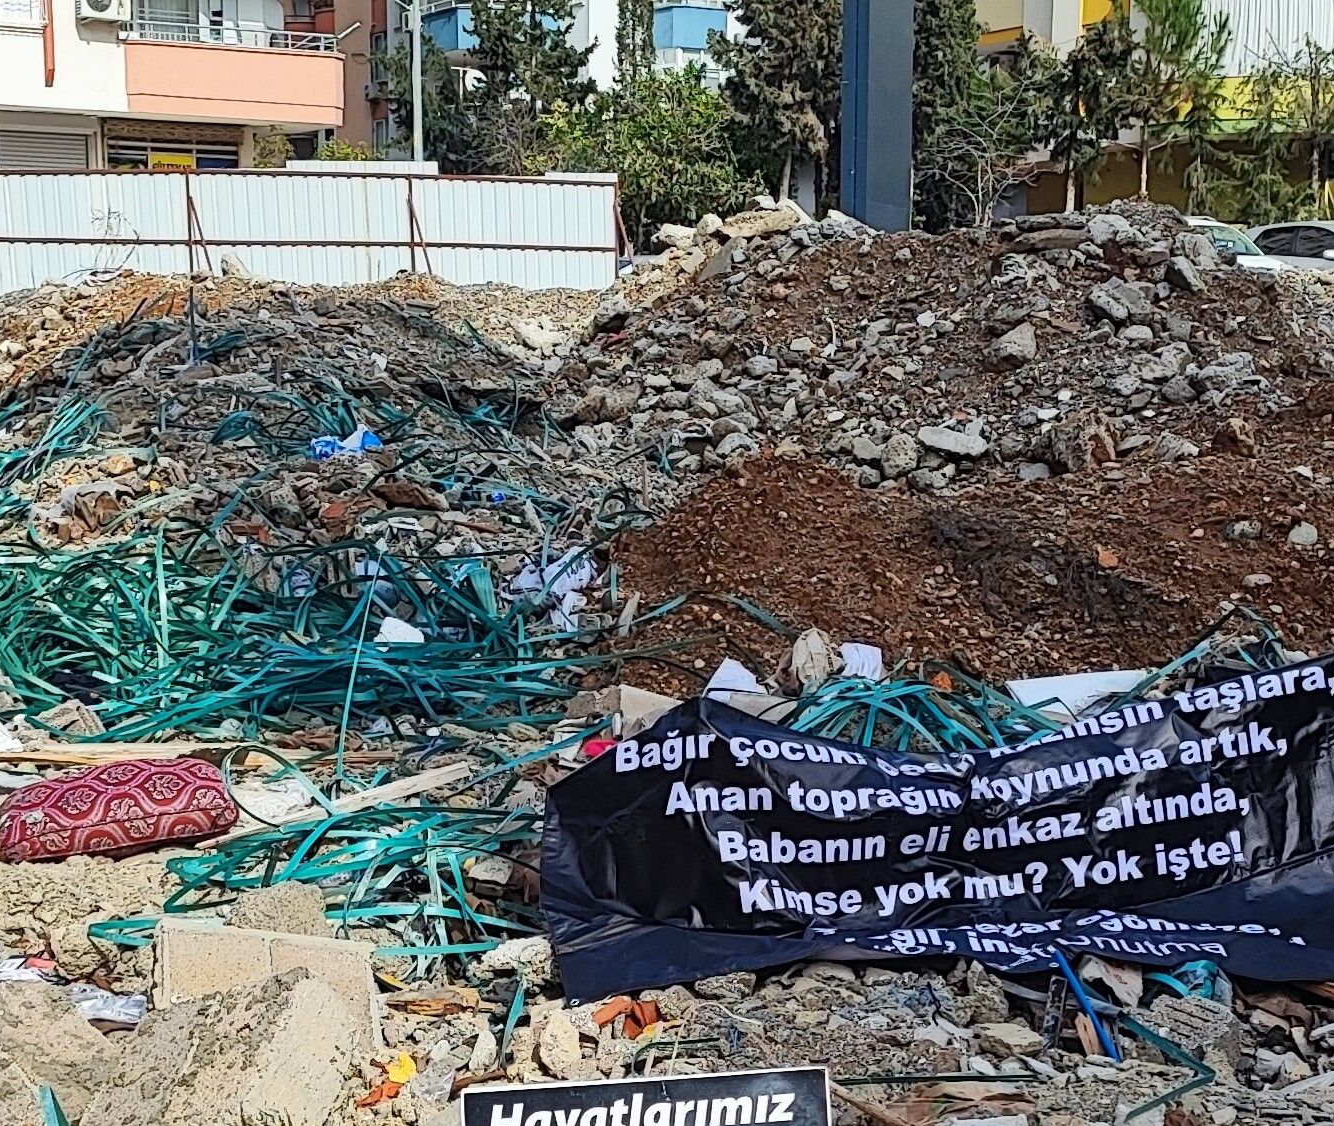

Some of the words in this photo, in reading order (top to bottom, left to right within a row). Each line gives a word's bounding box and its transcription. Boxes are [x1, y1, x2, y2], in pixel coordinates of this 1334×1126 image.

[615, 730, 717, 773] Bağır
[665, 780, 773, 816] Anan
[787, 779, 963, 819] toprağın
[1178, 721, 1288, 766] artık,
[717, 830, 886, 864] Babanın
[899, 824, 951, 855] eli
[963, 811, 1086, 852] enkaz
[1096, 782, 1250, 833] altında,
[739, 878, 863, 917] Kimse
[874, 871, 950, 917] yok
[963, 862, 1049, 901] mu?
[1061, 849, 1143, 889] Yok
[1155, 830, 1246, 882] işte!
